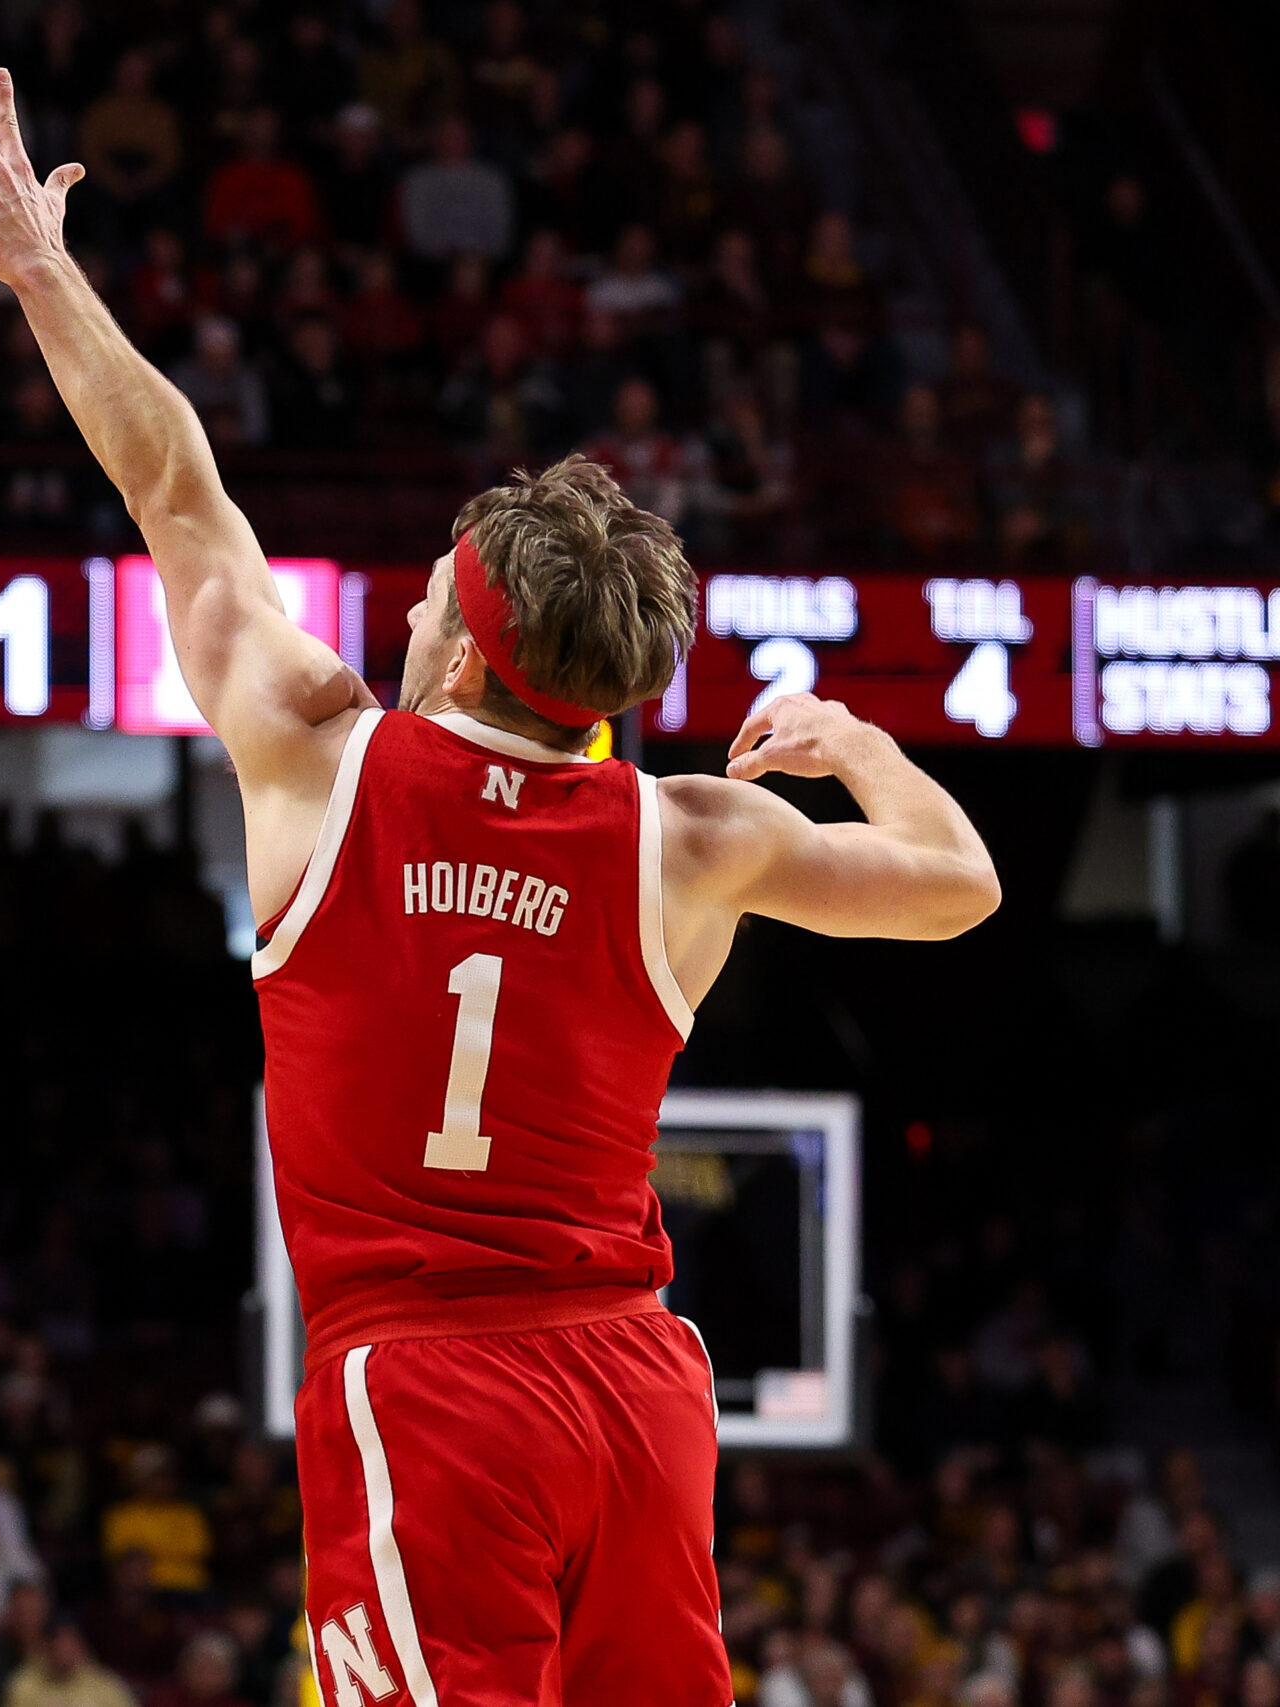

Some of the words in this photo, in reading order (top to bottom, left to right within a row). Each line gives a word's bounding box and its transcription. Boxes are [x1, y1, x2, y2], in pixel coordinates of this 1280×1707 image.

[1095, 584, 1280, 661] HUSTL
[943, 641, 1018, 738] 4
[480, 763, 527, 810] N
[403, 861, 570, 937] HOIBERG
[423, 952, 504, 1172] 1
[320, 1601, 399, 1707] N
